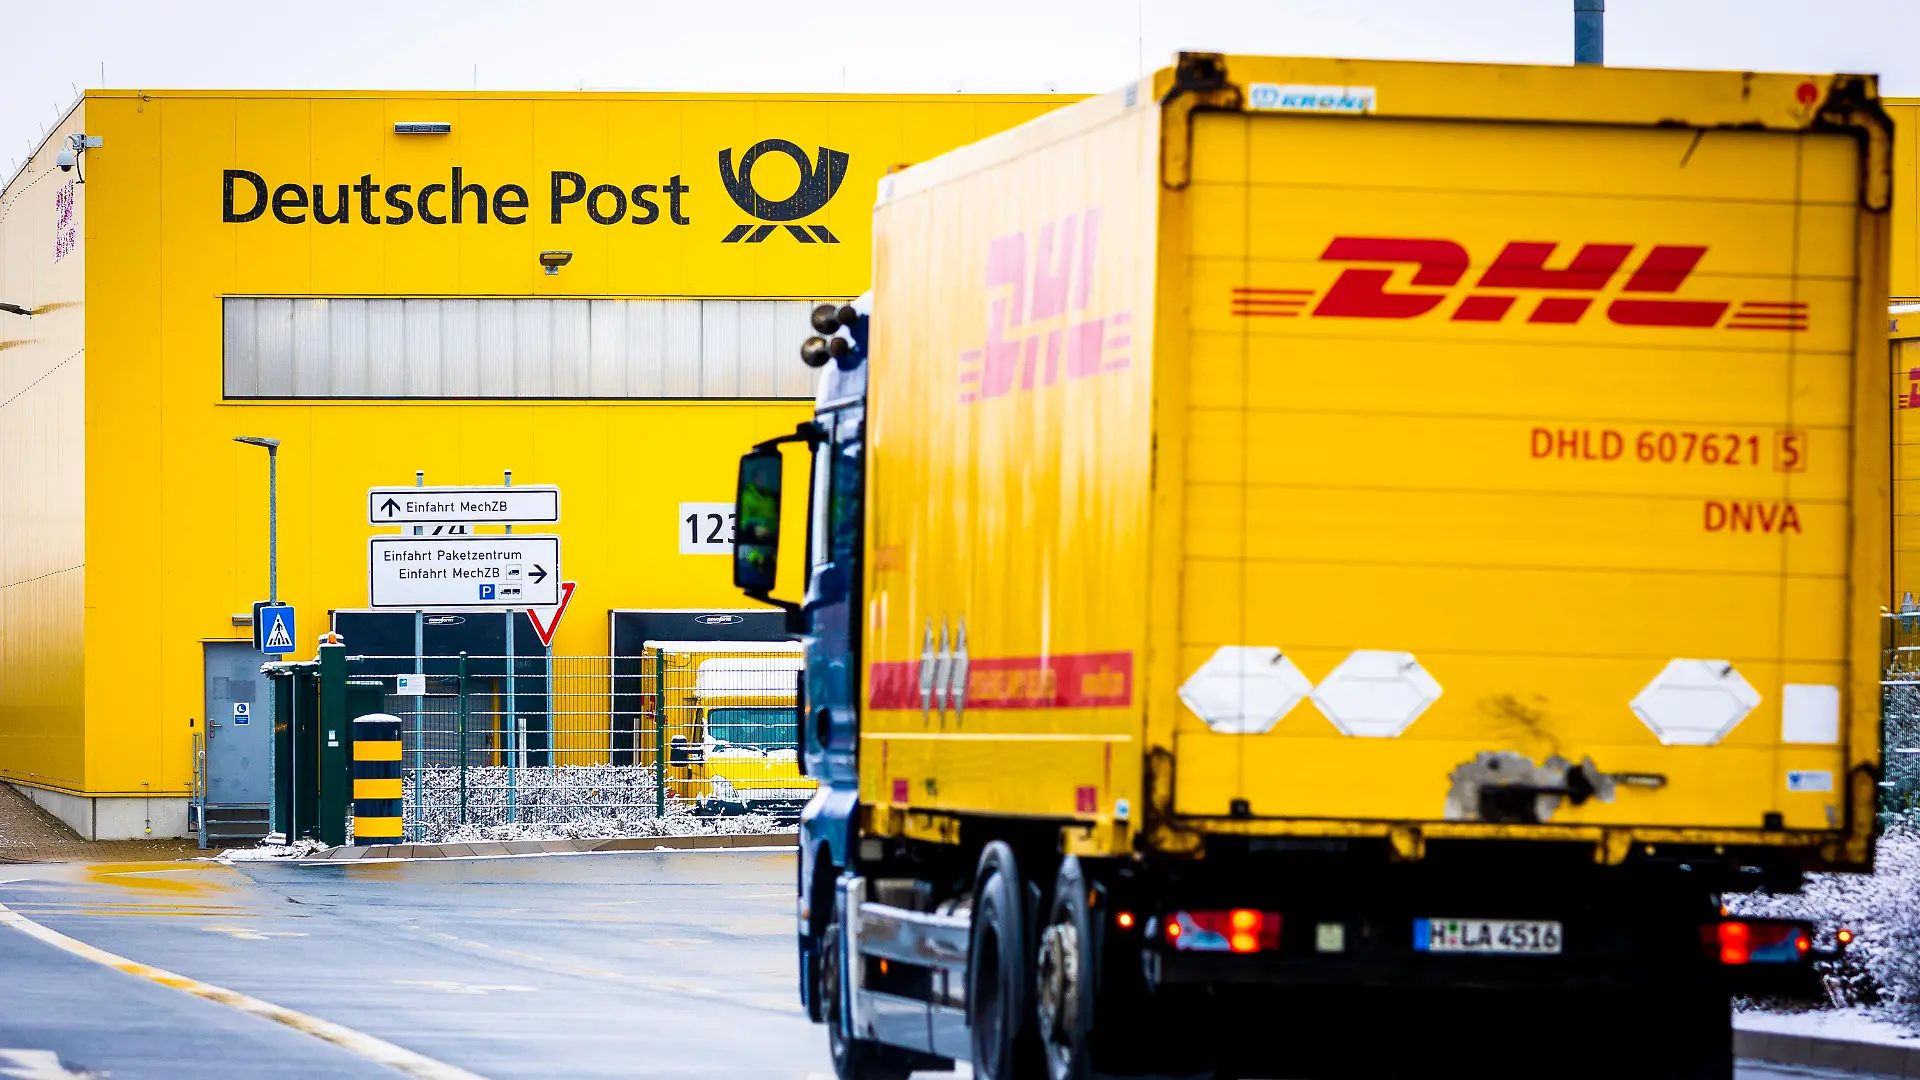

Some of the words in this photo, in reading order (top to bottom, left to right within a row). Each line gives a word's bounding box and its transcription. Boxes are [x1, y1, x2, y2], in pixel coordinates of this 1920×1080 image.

[222, 166, 529, 226] Deutsche
[551, 171, 690, 226] Post
[1310, 236, 1732, 329] DHL
[1529, 427, 1625, 461] DHLD
[1636, 430, 1759, 467] 607621
[1782, 435, 1799, 467] 5
[406, 501, 455, 513] Einfahrt
[460, 501, 508, 512] MechZB
[1704, 501, 1802, 534] DNVA
[383, 550, 432, 562] Einfahrt
[437, 550, 522, 561] Paketzentrum
[399, 568, 447, 579] Einfahrt
[452, 567, 500, 578] MechZB
[1431, 924, 1446, 944] H
[1462, 925, 1492, 946] LA
